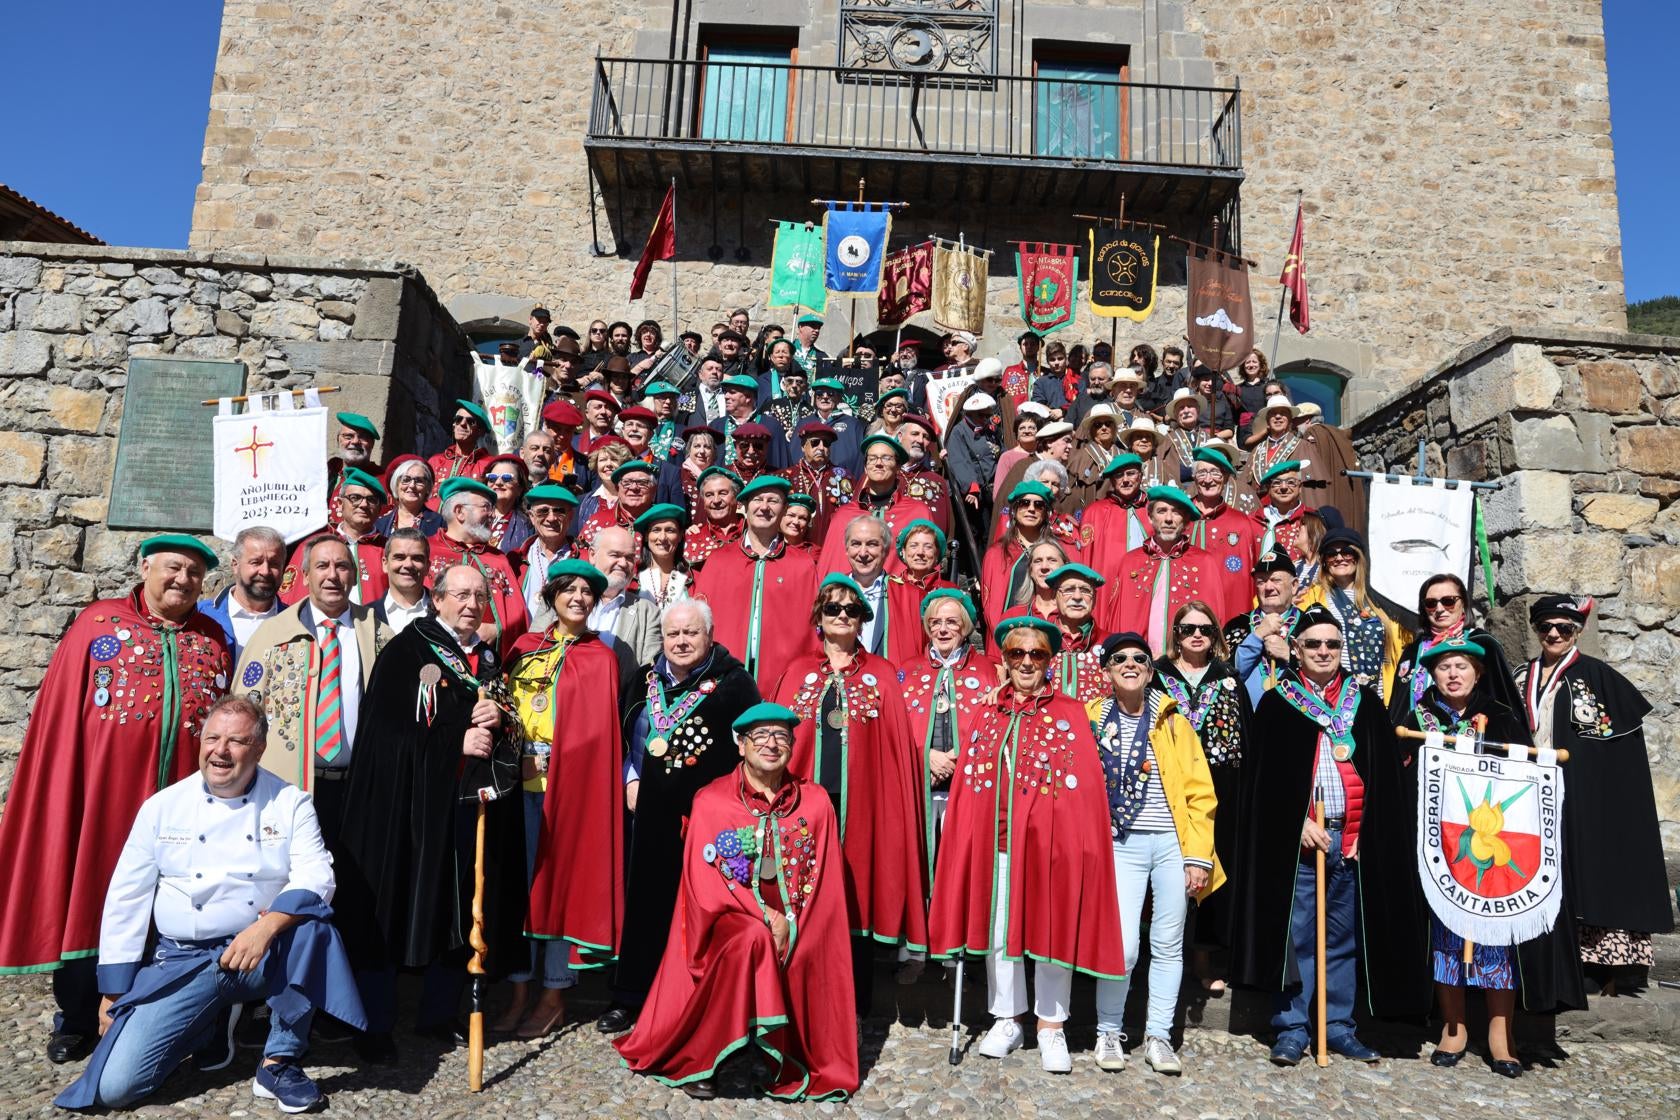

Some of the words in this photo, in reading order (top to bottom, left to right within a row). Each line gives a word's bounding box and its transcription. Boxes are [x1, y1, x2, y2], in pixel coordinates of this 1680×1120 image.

[263, 482, 306, 493] JUBILAR
[240, 493, 298, 506] LEBANIEGO
[1445, 763, 1475, 773] FUNDADA
[1478, 759, 1505, 775] DEL
[1428, 767, 1441, 848] COFRADIA
[1541, 784, 1554, 840] QUESO
[1544, 850, 1556, 868] DE
[1438, 873, 1539, 914] CANTABRIA
